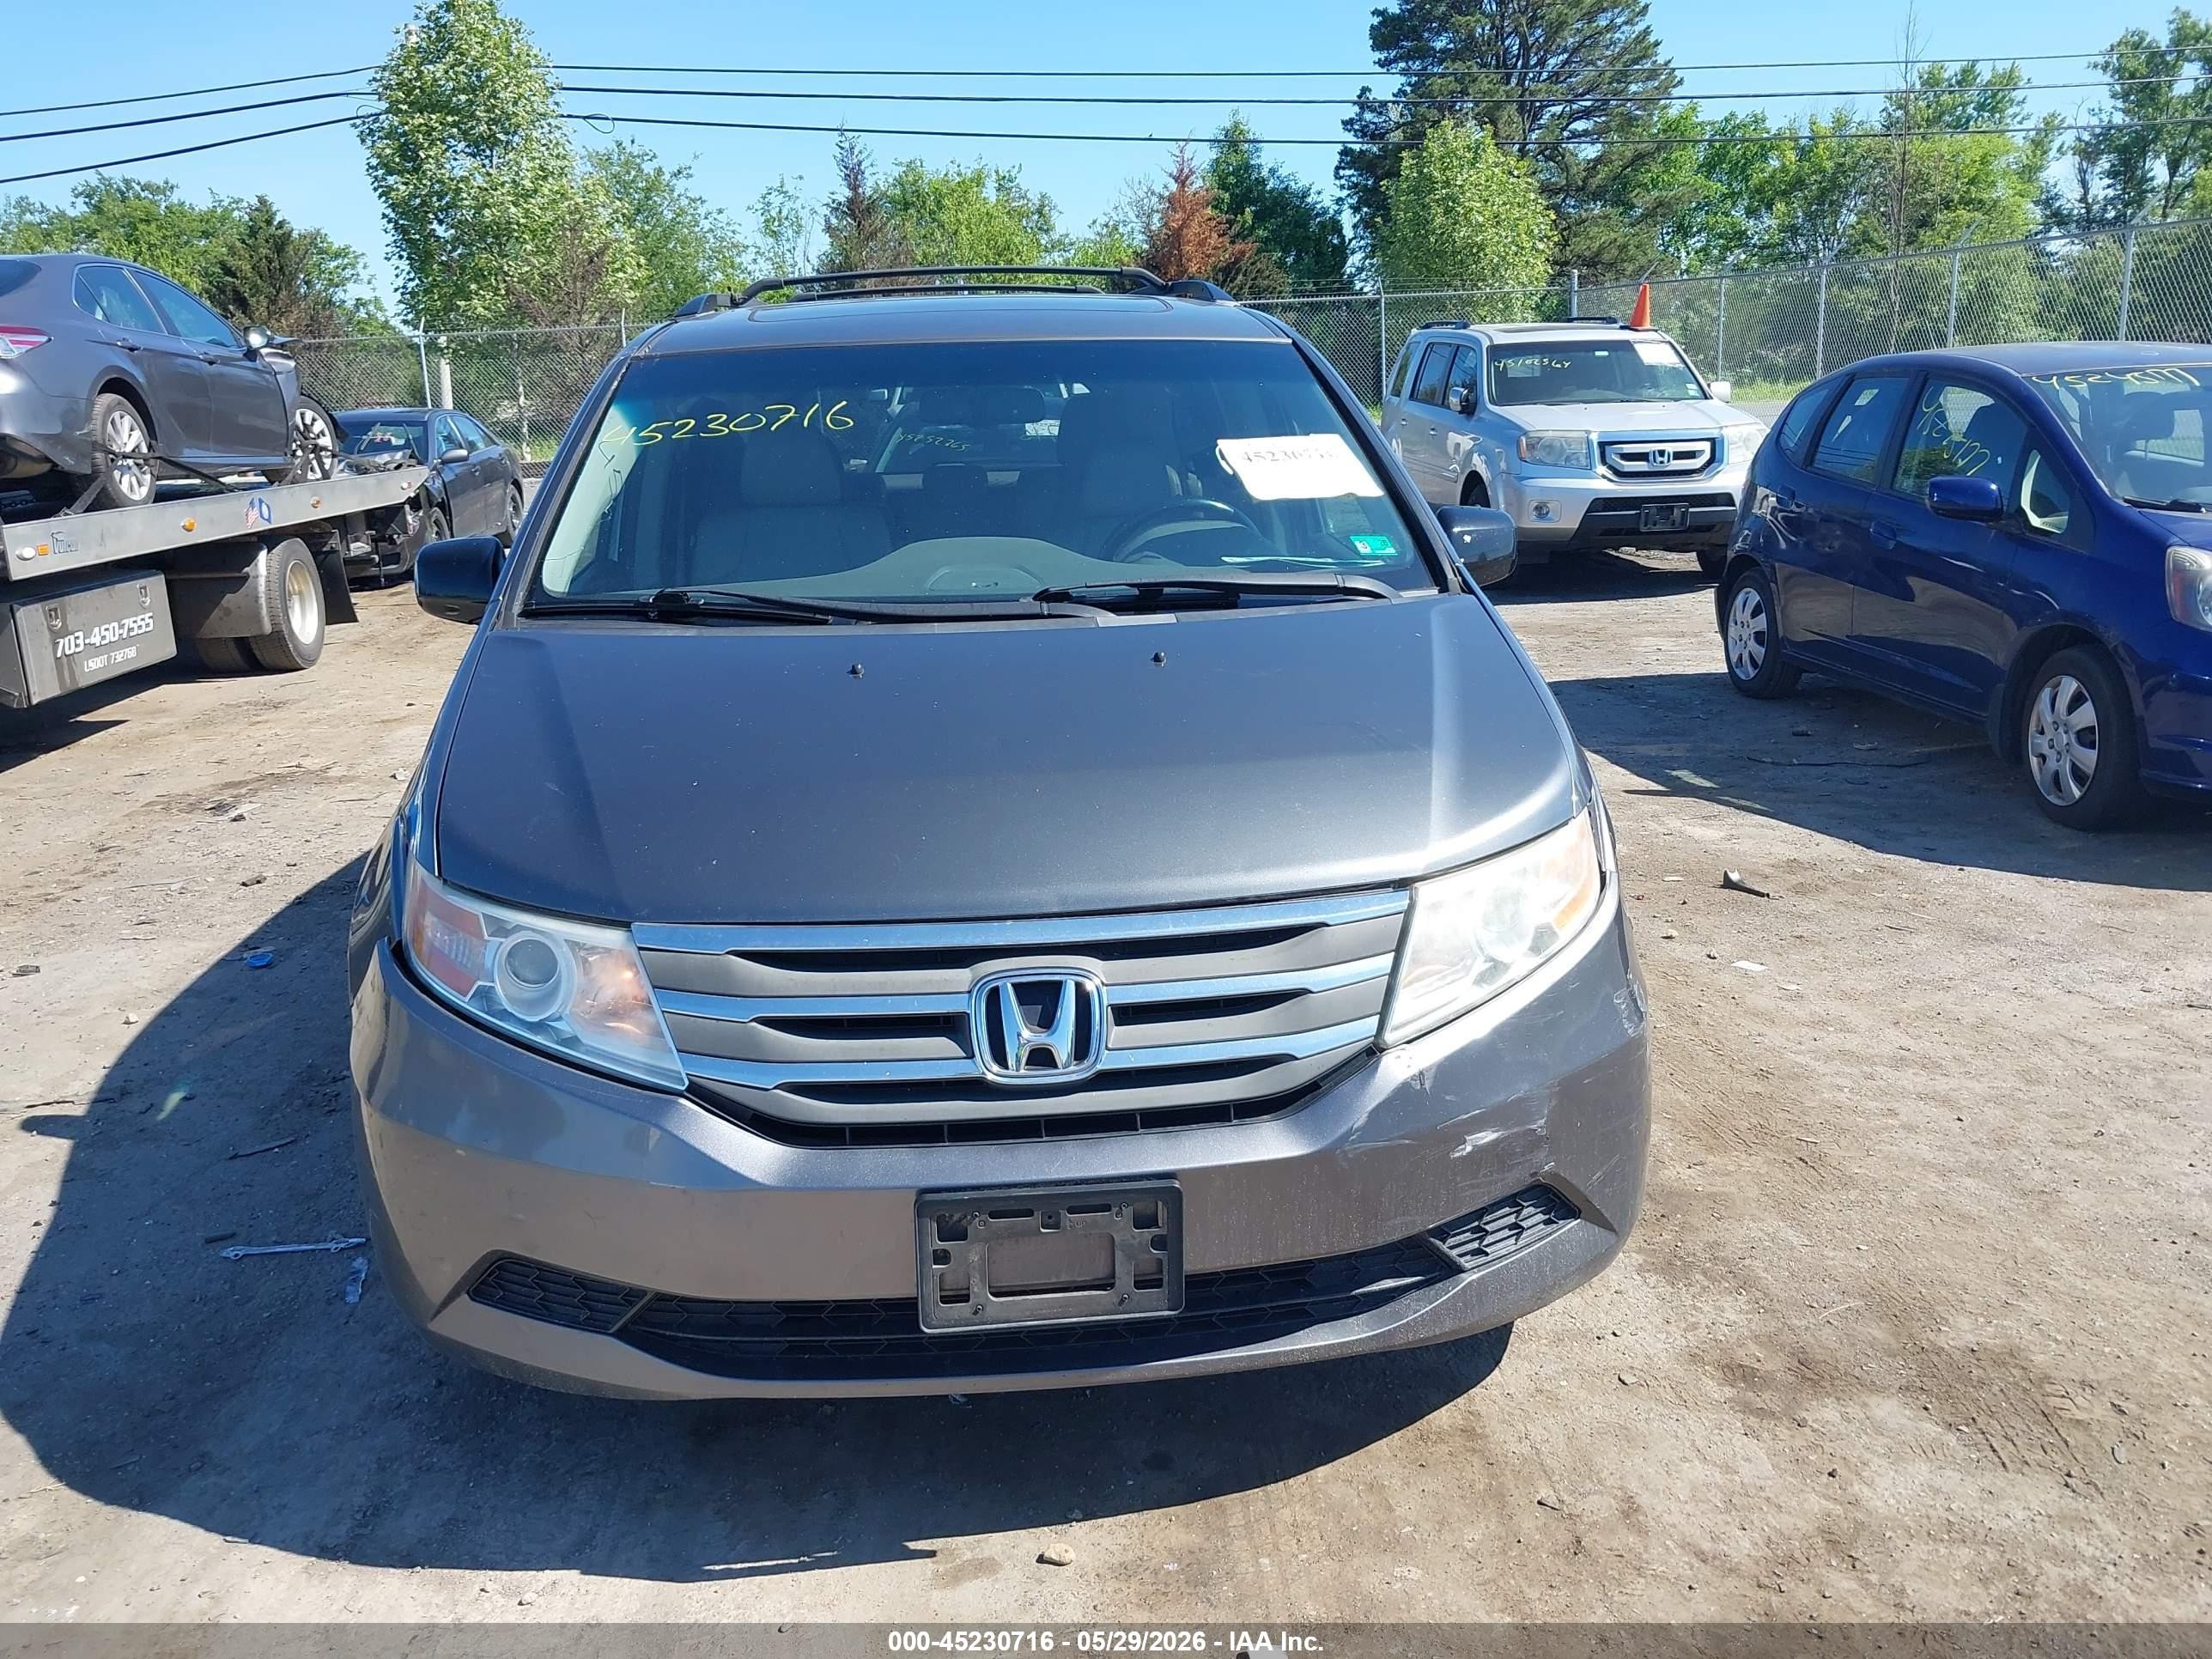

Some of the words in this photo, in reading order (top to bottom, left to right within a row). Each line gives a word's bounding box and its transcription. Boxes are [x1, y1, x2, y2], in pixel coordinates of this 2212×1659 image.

[603, 400, 854, 446] 45230716
[54, 611, 154, 659] 703-450-7555
[84, 654, 108, 672] USDOT
